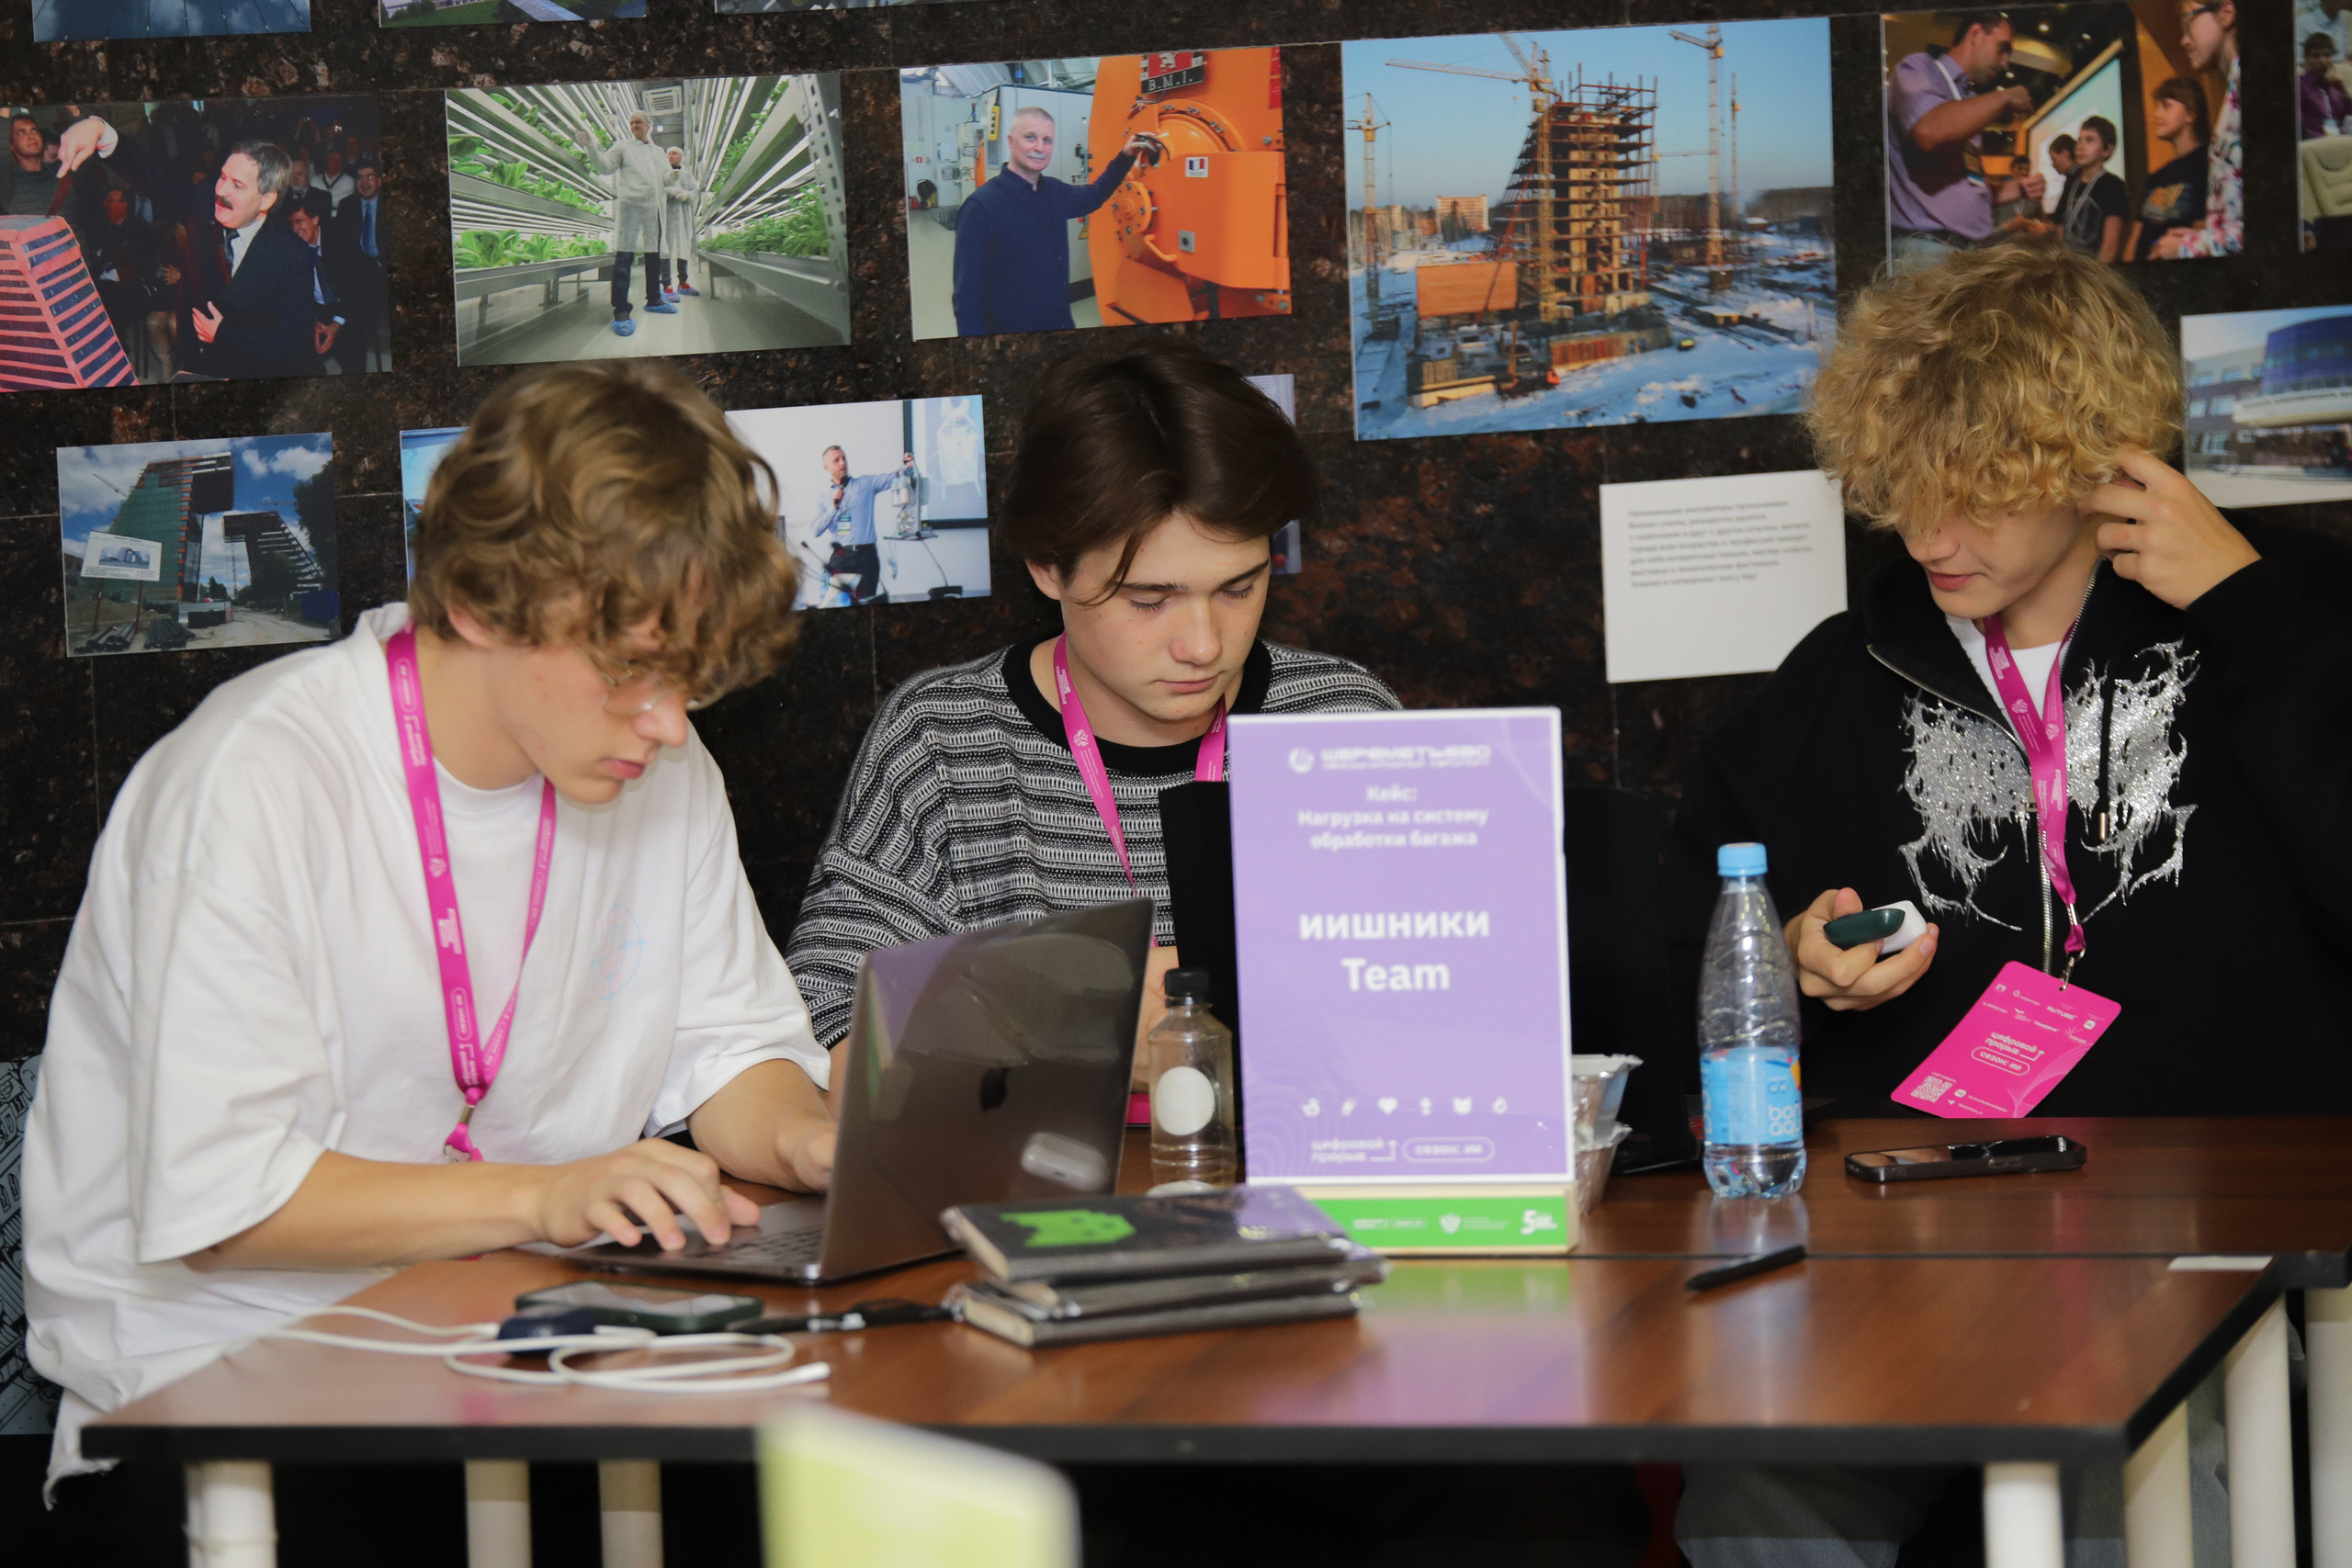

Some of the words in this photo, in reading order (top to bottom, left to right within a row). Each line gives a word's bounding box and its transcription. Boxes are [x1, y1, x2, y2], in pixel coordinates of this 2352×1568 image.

[1148, 70, 1193, 92] B.M.I.
[1365, 784, 1418, 802] Кейс:
[1297, 809, 1384, 829] Нагрузка
[1386, 811, 1410, 824] на
[1413, 808, 1489, 827] систему
[1309, 830, 1407, 852] обработки
[1409, 829, 1477, 847] багажа
[1340, 957, 1451, 992] Team
[1990, 1031, 2038, 1054] цифровой
[1310, 1137, 1385, 1152] цифровой
[1414, 1144, 1461, 1156] сезон:
[1311, 1151, 1367, 1165] прорыв
